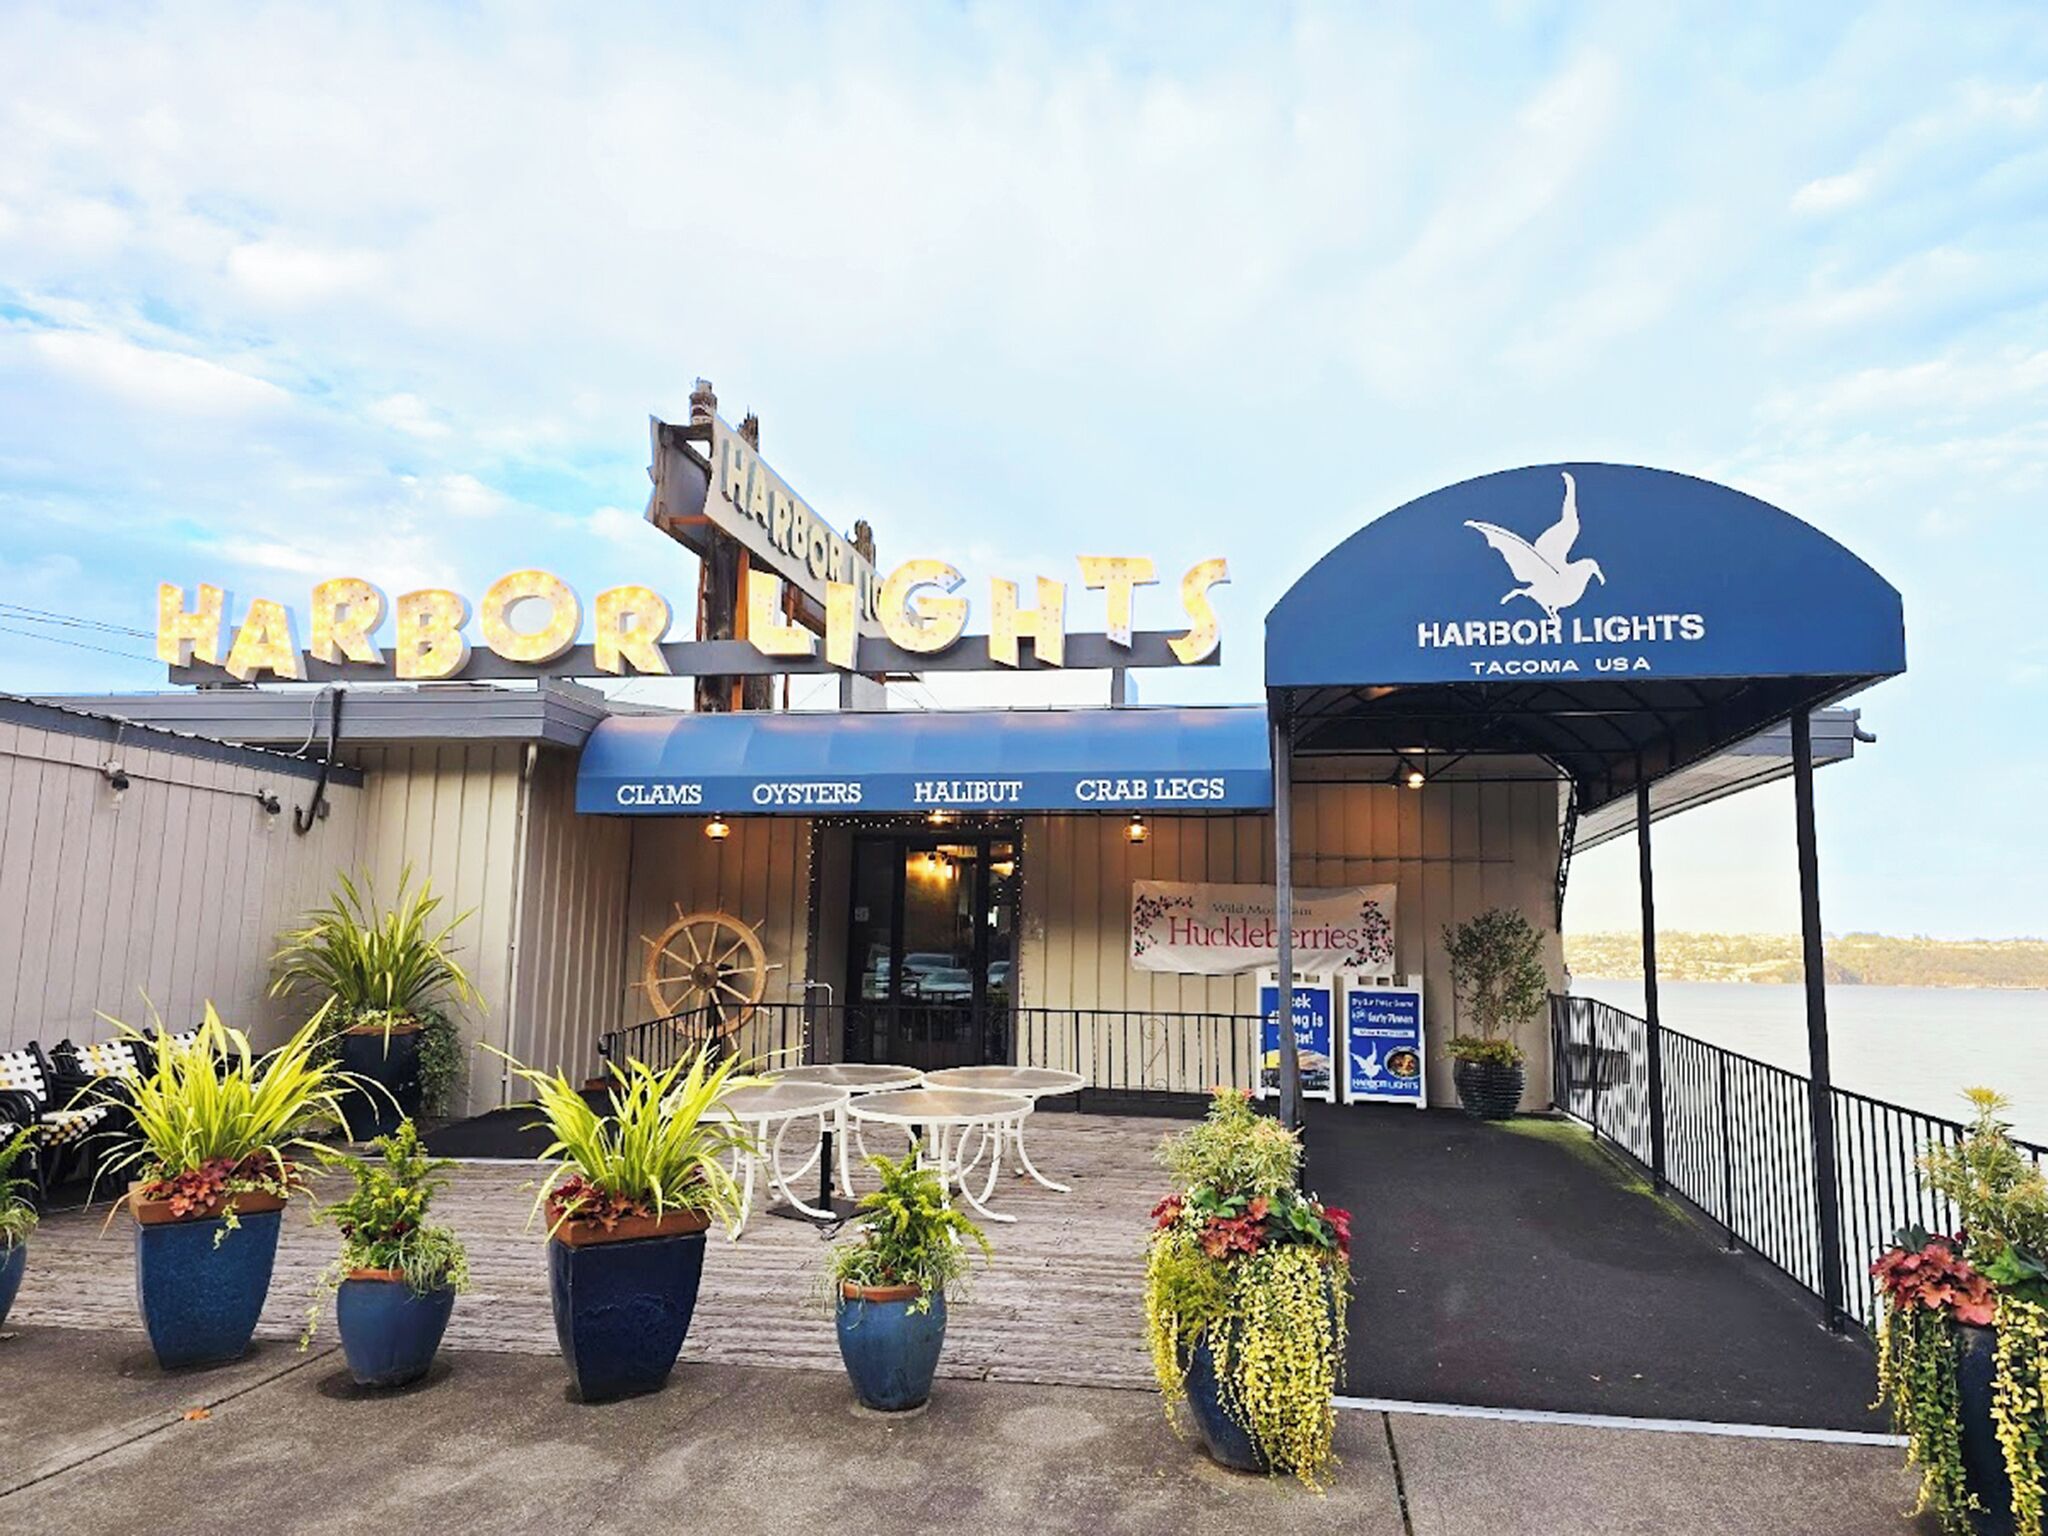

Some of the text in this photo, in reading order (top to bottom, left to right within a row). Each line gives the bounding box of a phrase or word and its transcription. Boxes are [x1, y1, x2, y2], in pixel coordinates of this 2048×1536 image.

[721, 439, 845, 583] HARBOR
[156, 568, 674, 682] HARBOR
[748, 554, 1231, 671] LIGHTS
[1417, 614, 1706, 648] HARBOR LIGHTS
[1470, 656, 1651, 675] TACOMA USA
[617, 783, 703, 806] CLAMS
[752, 782, 863, 805] OYSTERS
[914, 780, 1023, 803] HALIBUT
[1075, 777, 1226, 802] CRAB LEGS
[1212, 903, 1245, 914] Wild
[1312, 1012, 1324, 1028] is
